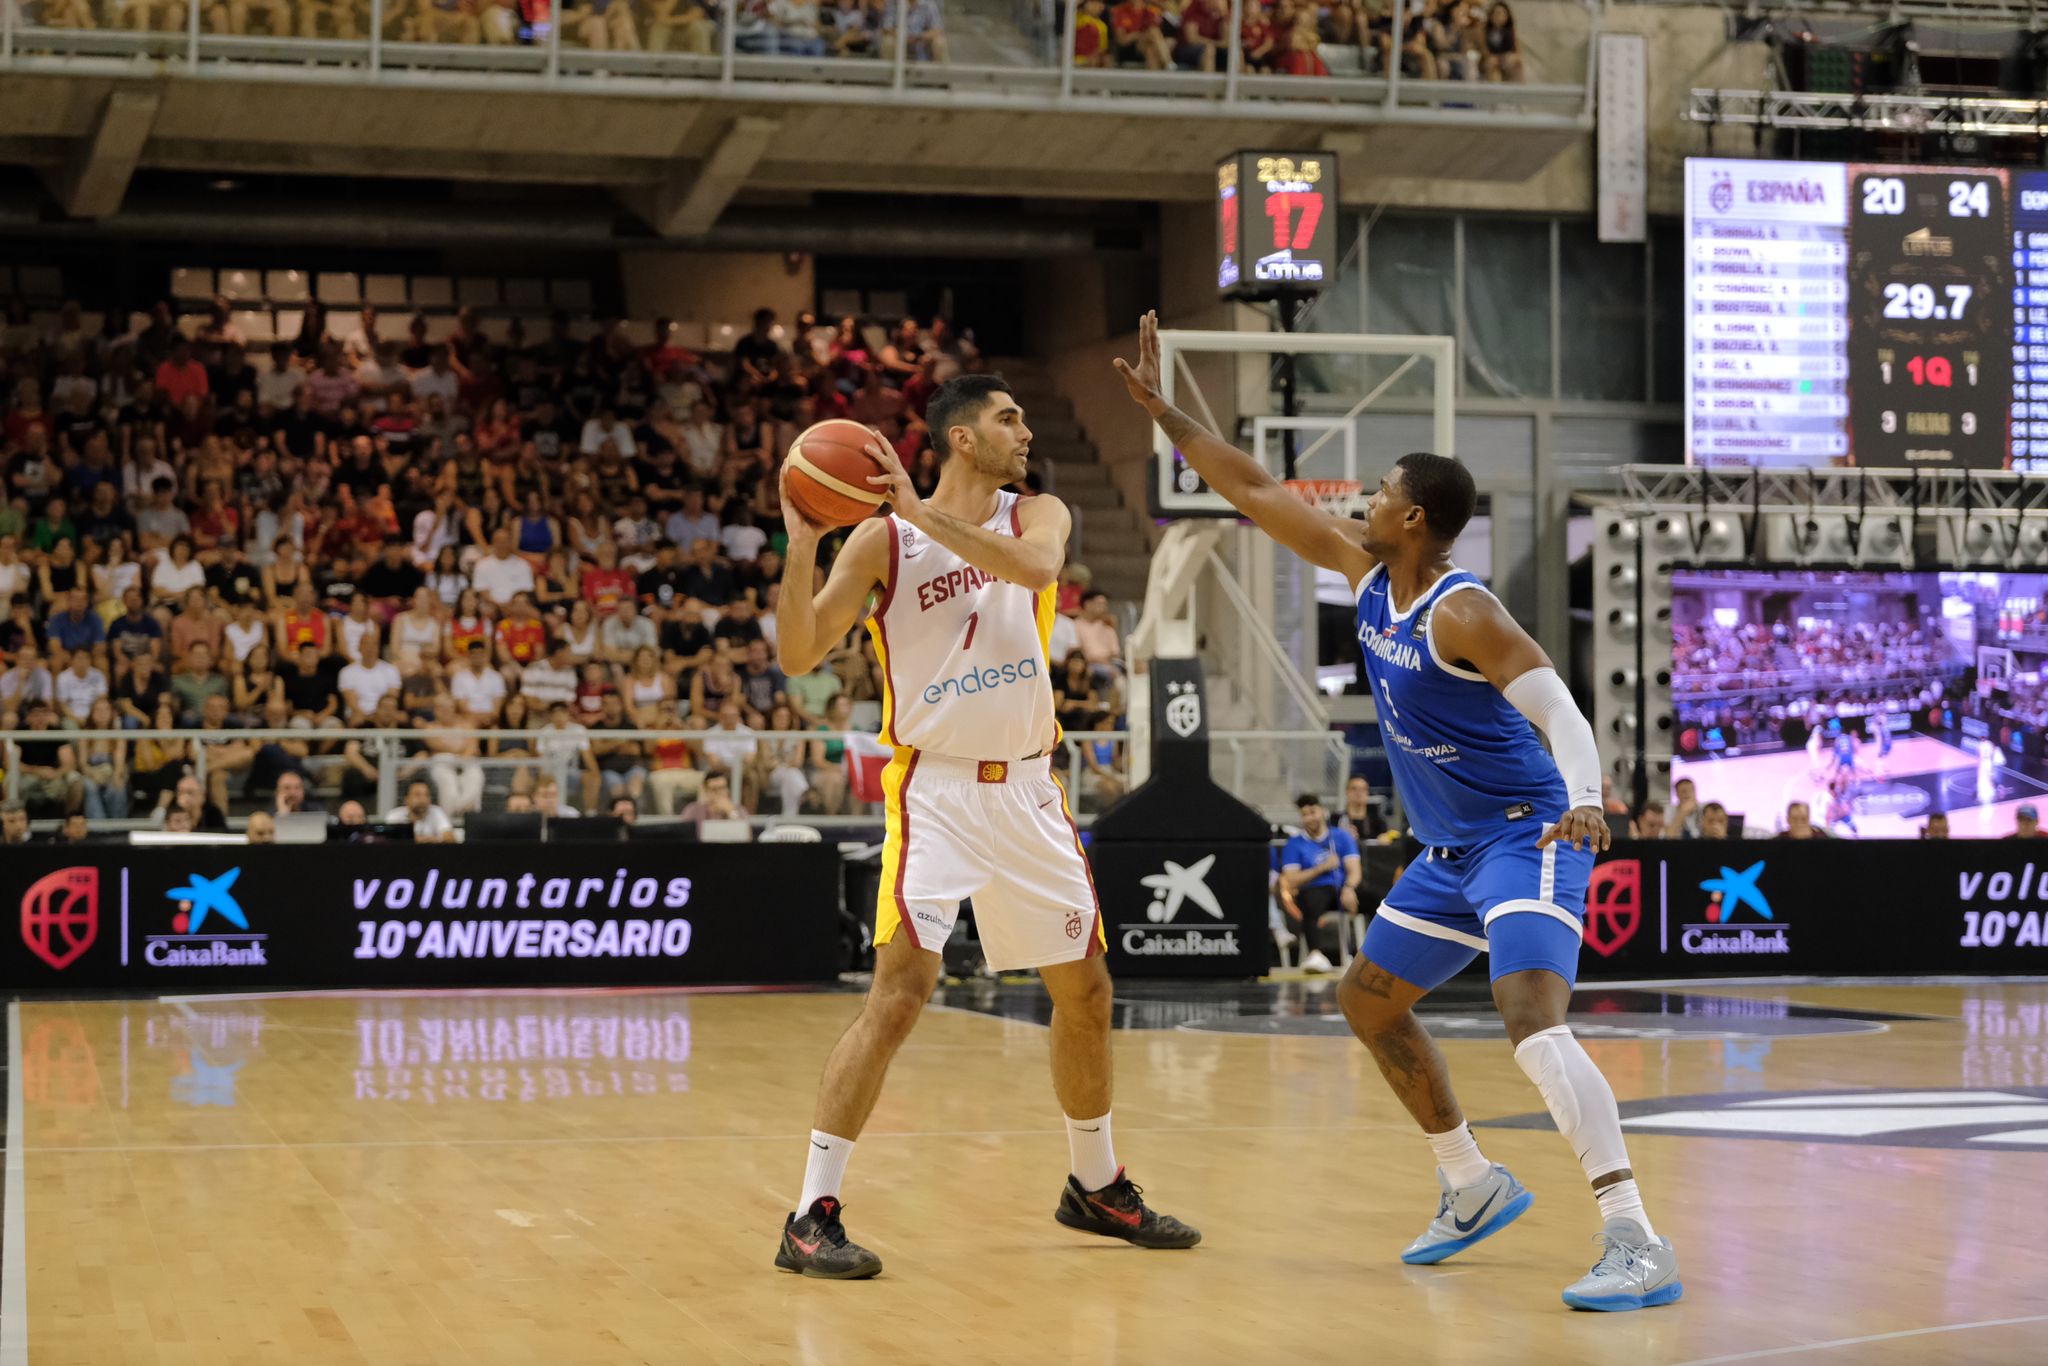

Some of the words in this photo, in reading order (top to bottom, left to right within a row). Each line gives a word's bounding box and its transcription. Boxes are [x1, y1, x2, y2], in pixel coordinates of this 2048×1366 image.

[1863, 178, 1905, 215] 20
[1948, 181, 1989, 218] 24
[1264, 192, 1324, 250] 17
[1884, 283, 1972, 320] 29.7
[1881, 361, 1892, 385] 1
[1907, 356, 1952, 388] 1Q
[1966, 363, 1978, 386] 1
[1881, 410, 1897, 434] 3
[1961, 412, 1977, 435] 3
[917, 566, 1012, 613] ESPA
[963, 611, 979, 651] 1
[923, 657, 1038, 704] endesa
[353, 867, 692, 910] voluntarios
[145, 940, 268, 967] CaixaBank
[1121, 929, 1241, 956] CaixaBank
[1681, 928, 1790, 955] CaixaBank
